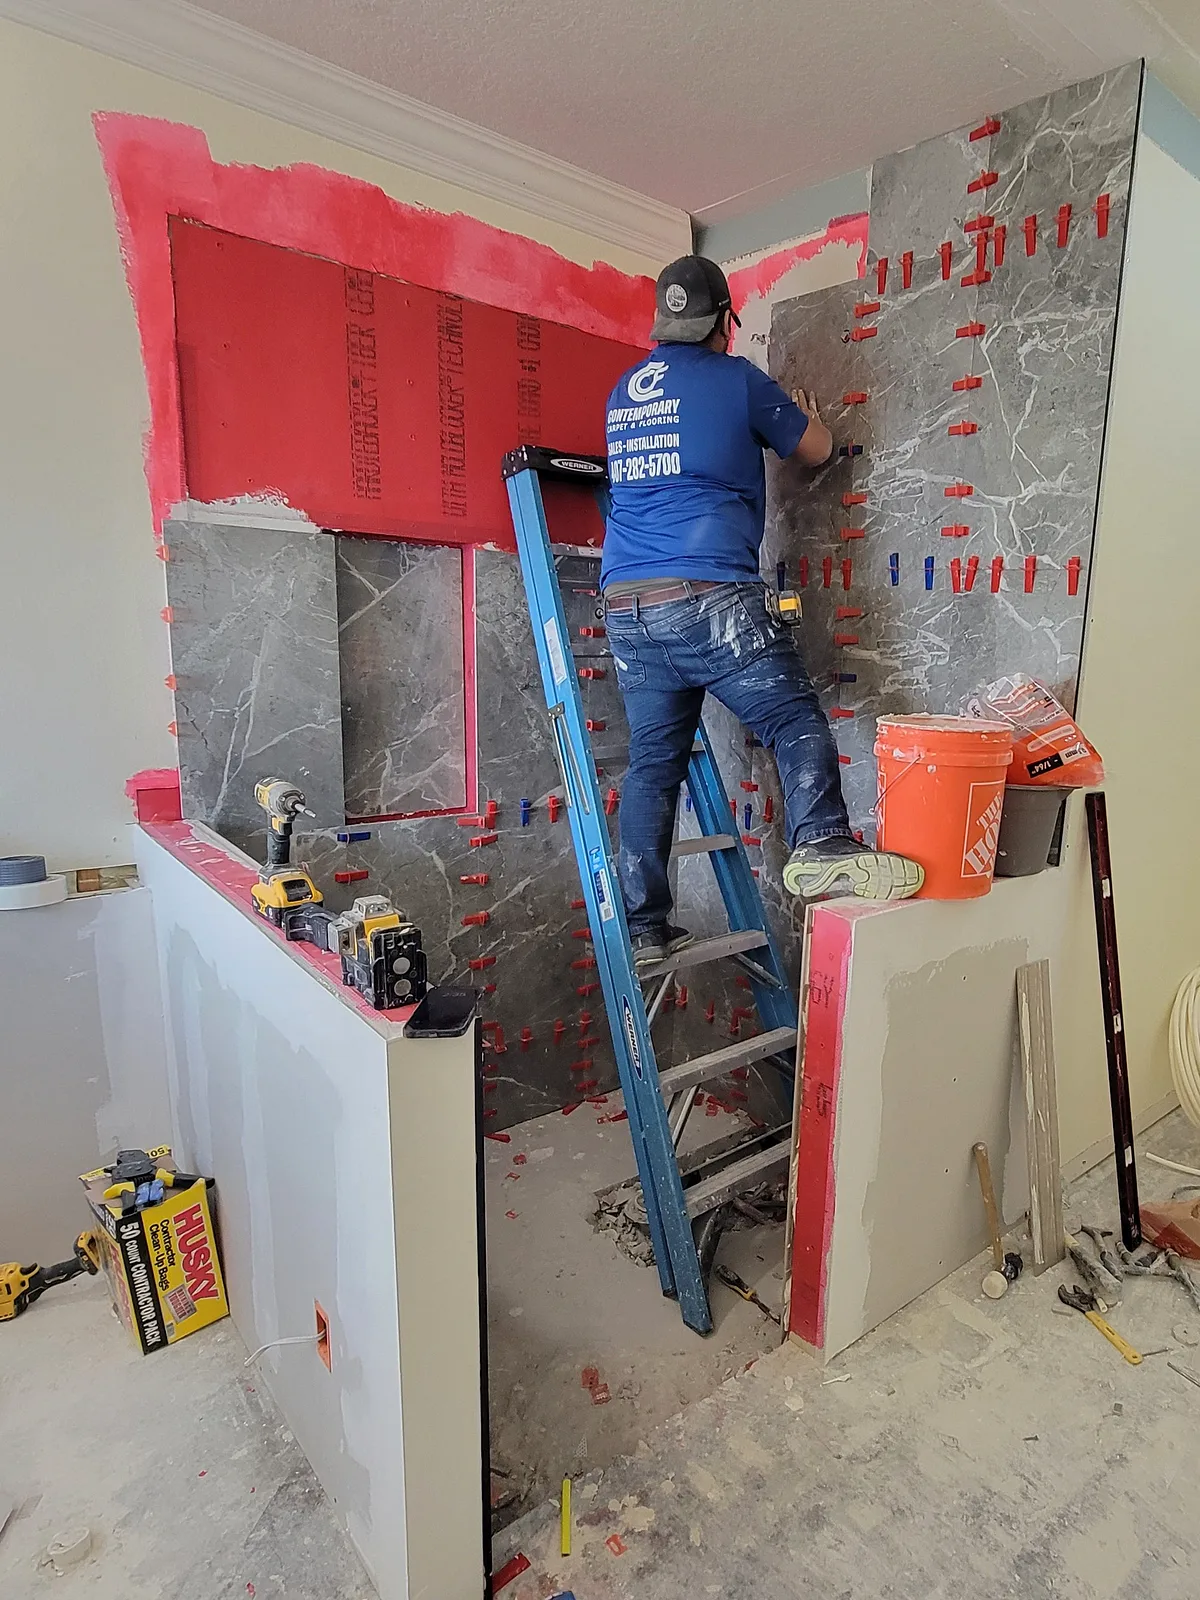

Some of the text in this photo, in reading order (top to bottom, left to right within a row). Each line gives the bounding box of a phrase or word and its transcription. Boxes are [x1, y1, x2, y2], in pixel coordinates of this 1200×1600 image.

[607, 399, 681, 424] CONTEMPORARY
[607, 423, 628, 433] CARPET
[639, 415, 680, 428] FLOORING
[561, 461, 594, 471] WERNER
[626, 1010, 640, 1066] WERNER
[120, 1221, 141, 1240] 50
[159, 1219, 176, 1267] Contractor
[125, 1240, 141, 1264] COUNT
[172, 1203, 219, 1303] HUSKY
[158, 1266, 170, 1291] Bags
[131, 1263, 156, 1322] CONTRACTOR
[143, 1320, 162, 1346] PACK
